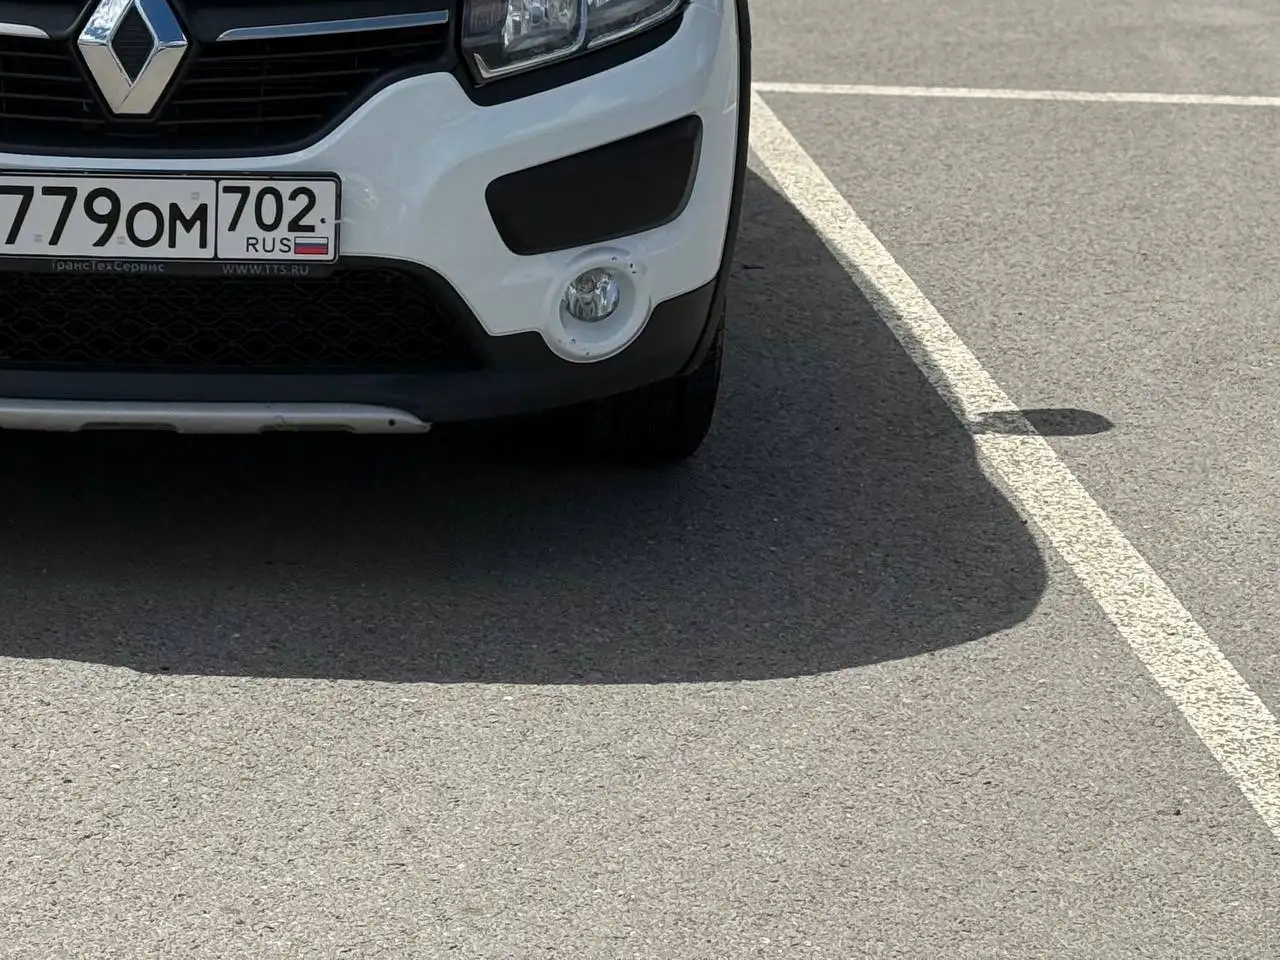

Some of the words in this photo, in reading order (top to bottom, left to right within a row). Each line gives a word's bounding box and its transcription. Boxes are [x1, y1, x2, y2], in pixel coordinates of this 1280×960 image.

[222, 185, 317, 233] 702
[246, 236, 292, 253] RUS
[221, 264, 310, 276] WWW.TTS.RU
